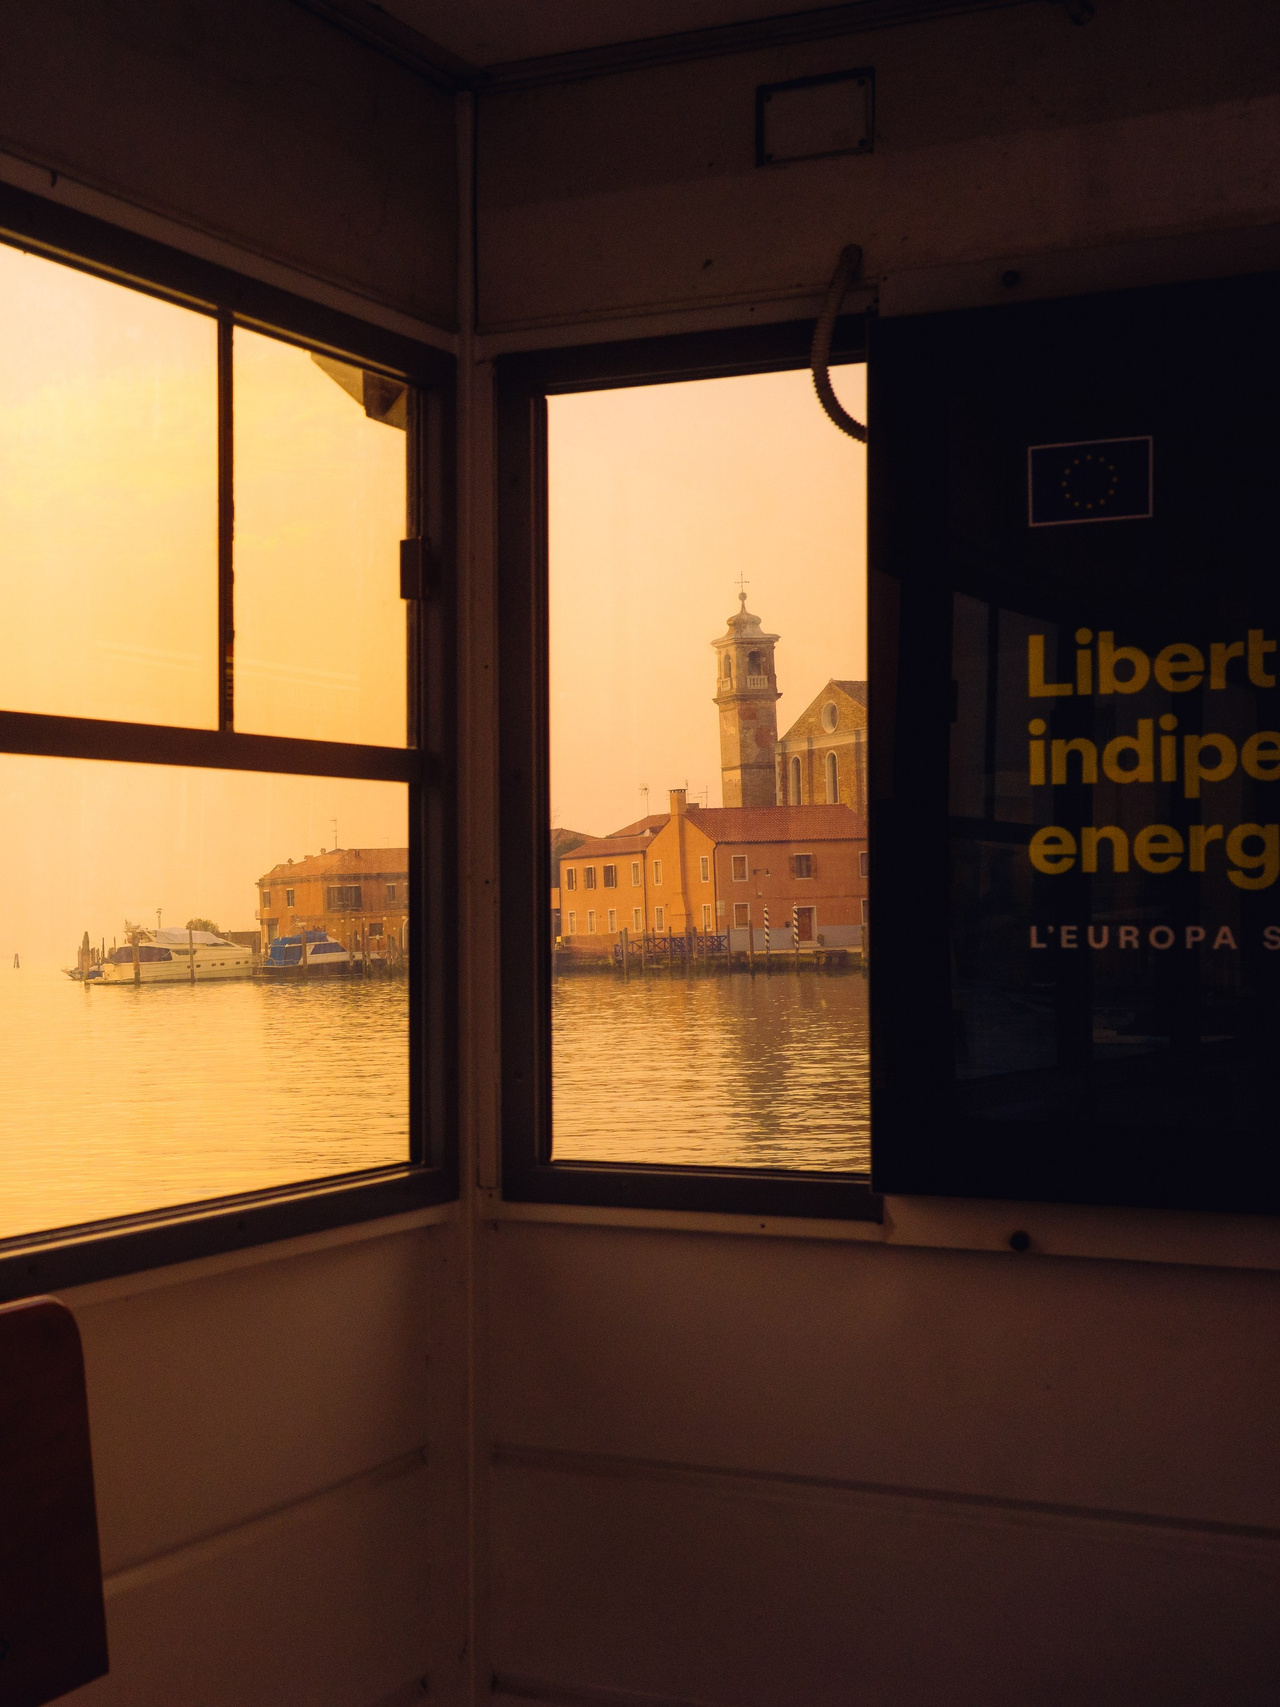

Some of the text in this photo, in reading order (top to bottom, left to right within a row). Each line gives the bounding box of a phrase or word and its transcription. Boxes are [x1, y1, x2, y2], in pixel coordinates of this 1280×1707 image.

[1028, 627, 1277, 698] Libert
[1028, 713, 1280, 799] indipe
[1028, 822, 1280, 891] energ
[1029, 925, 1238, 950] L'EUROPA
